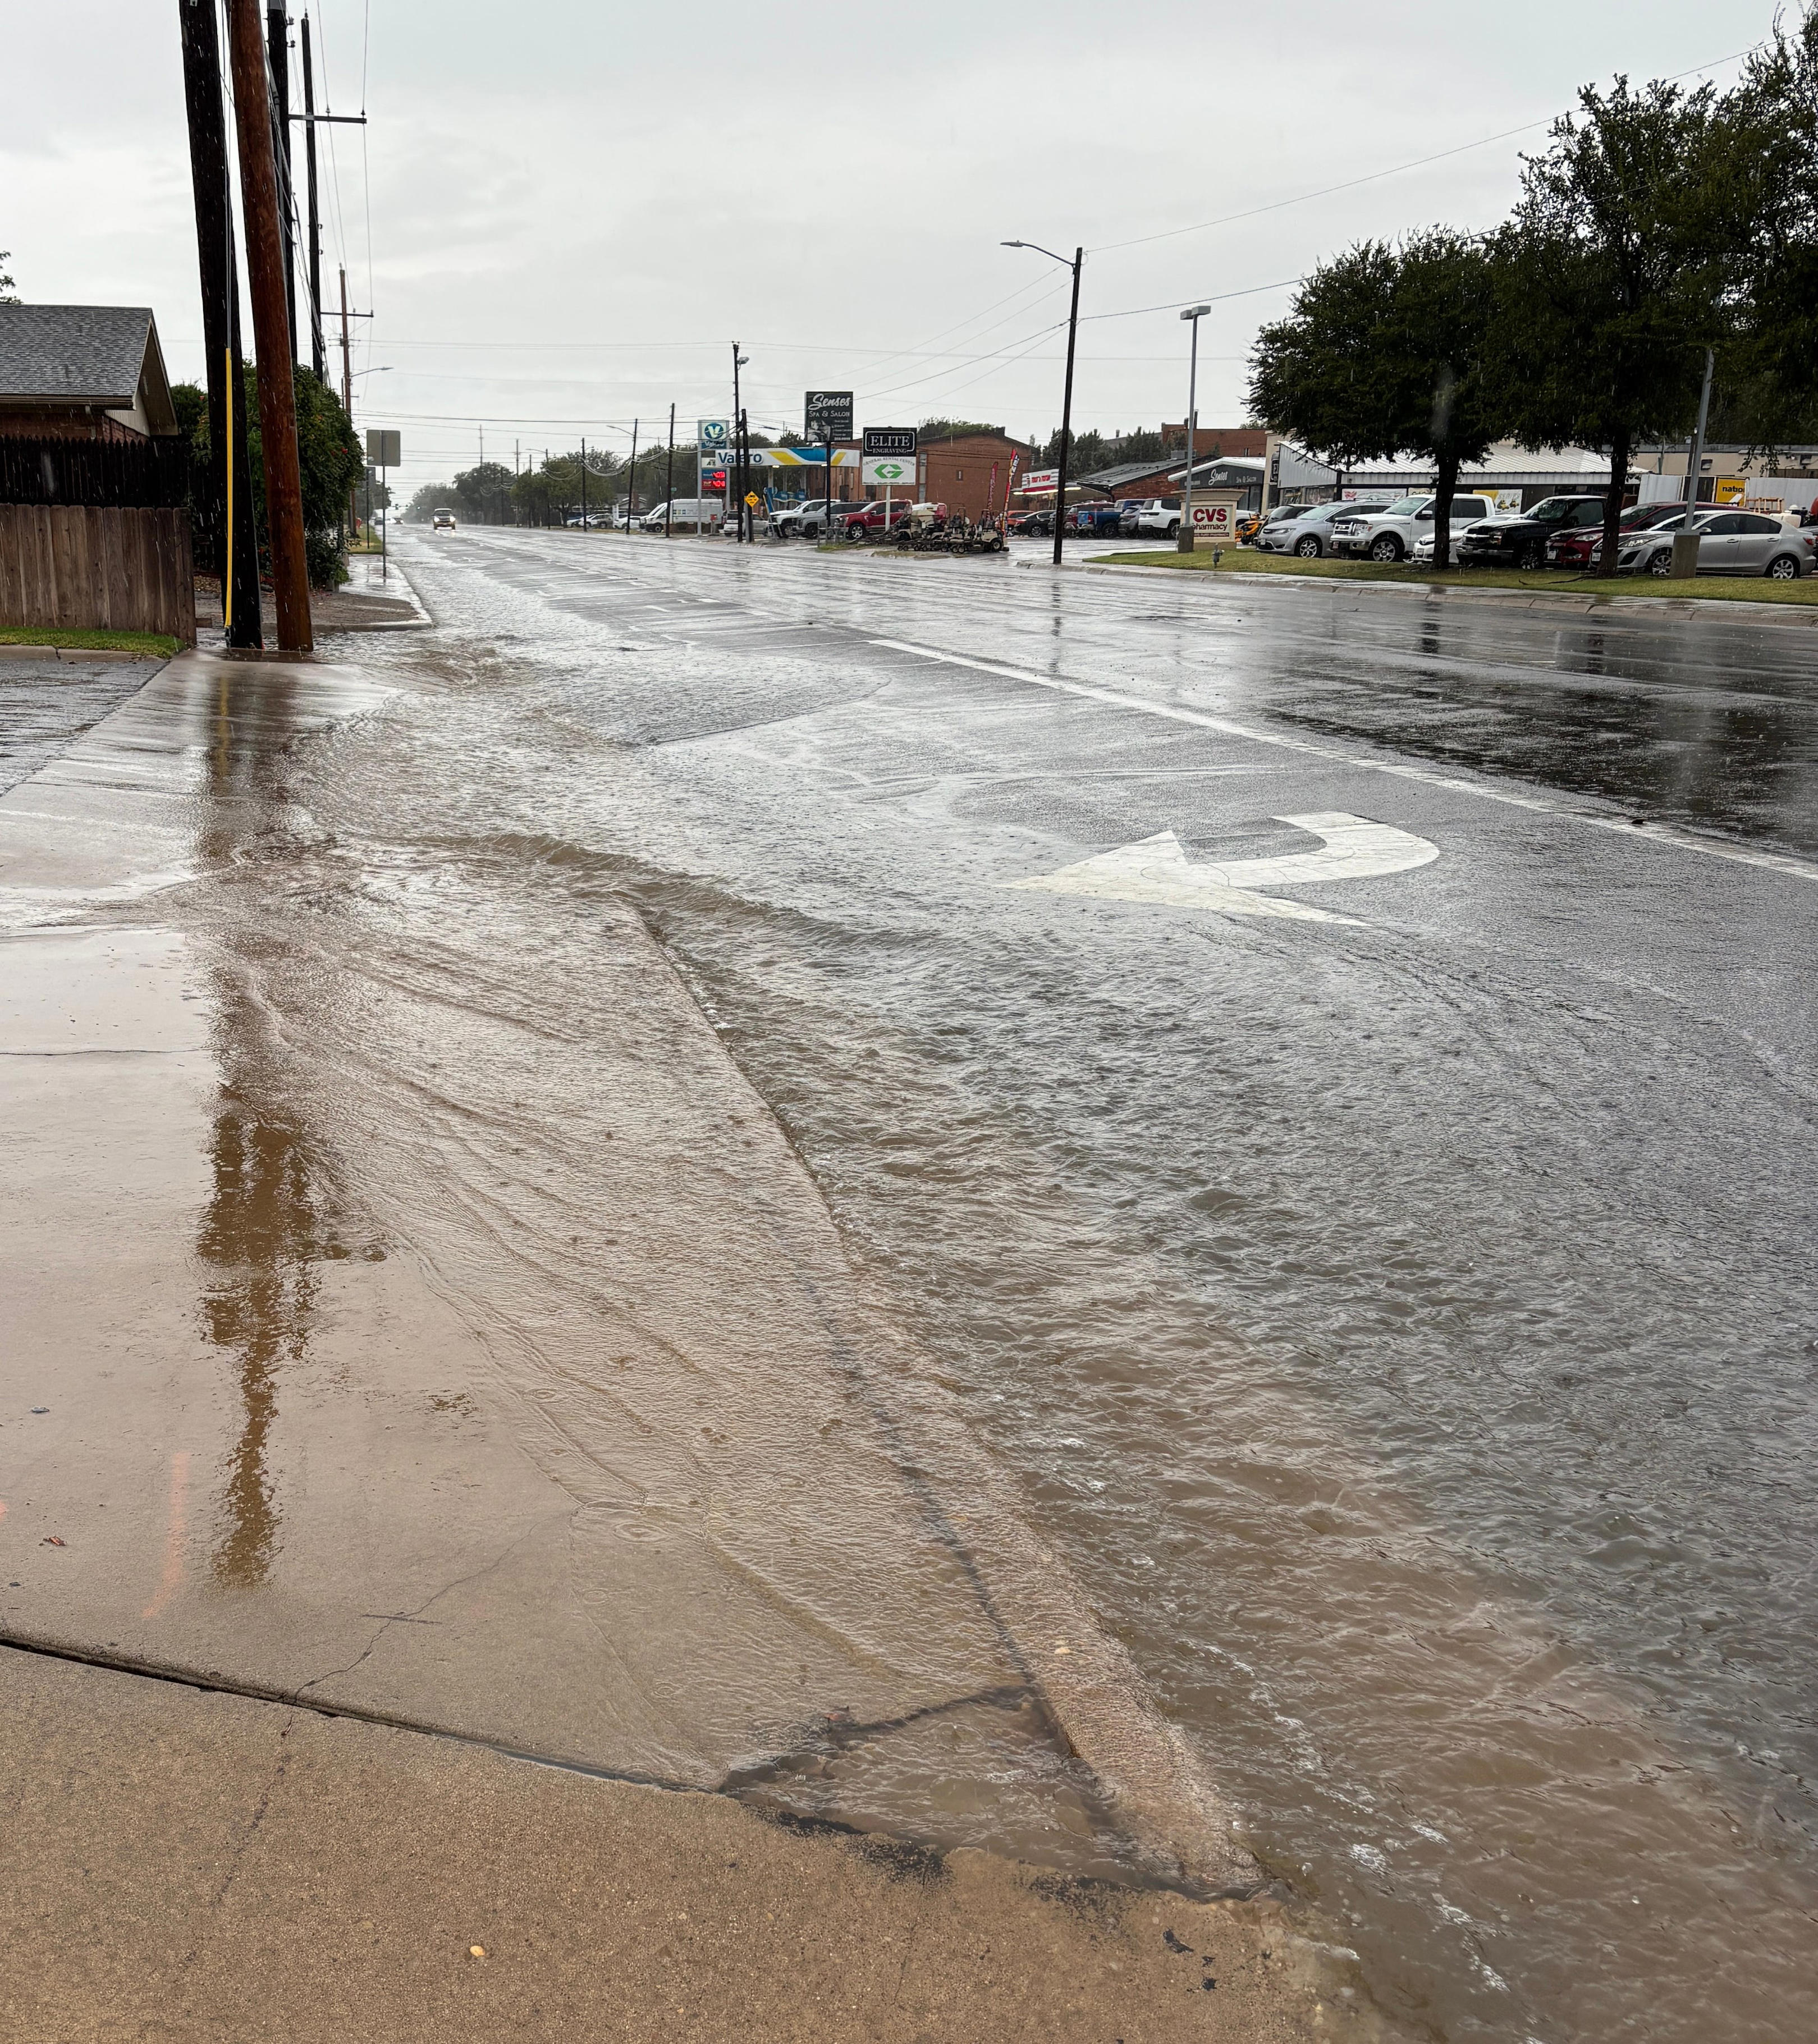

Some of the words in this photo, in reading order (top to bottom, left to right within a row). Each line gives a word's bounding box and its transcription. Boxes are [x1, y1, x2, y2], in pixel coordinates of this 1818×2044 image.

[808, 393, 851, 410] Senses
[871, 436, 910, 446] ELITE
[718, 452, 762, 464] Vaeo
[1208, 469, 1228, 485] Senses
[1193, 508, 1227, 523] CVS
